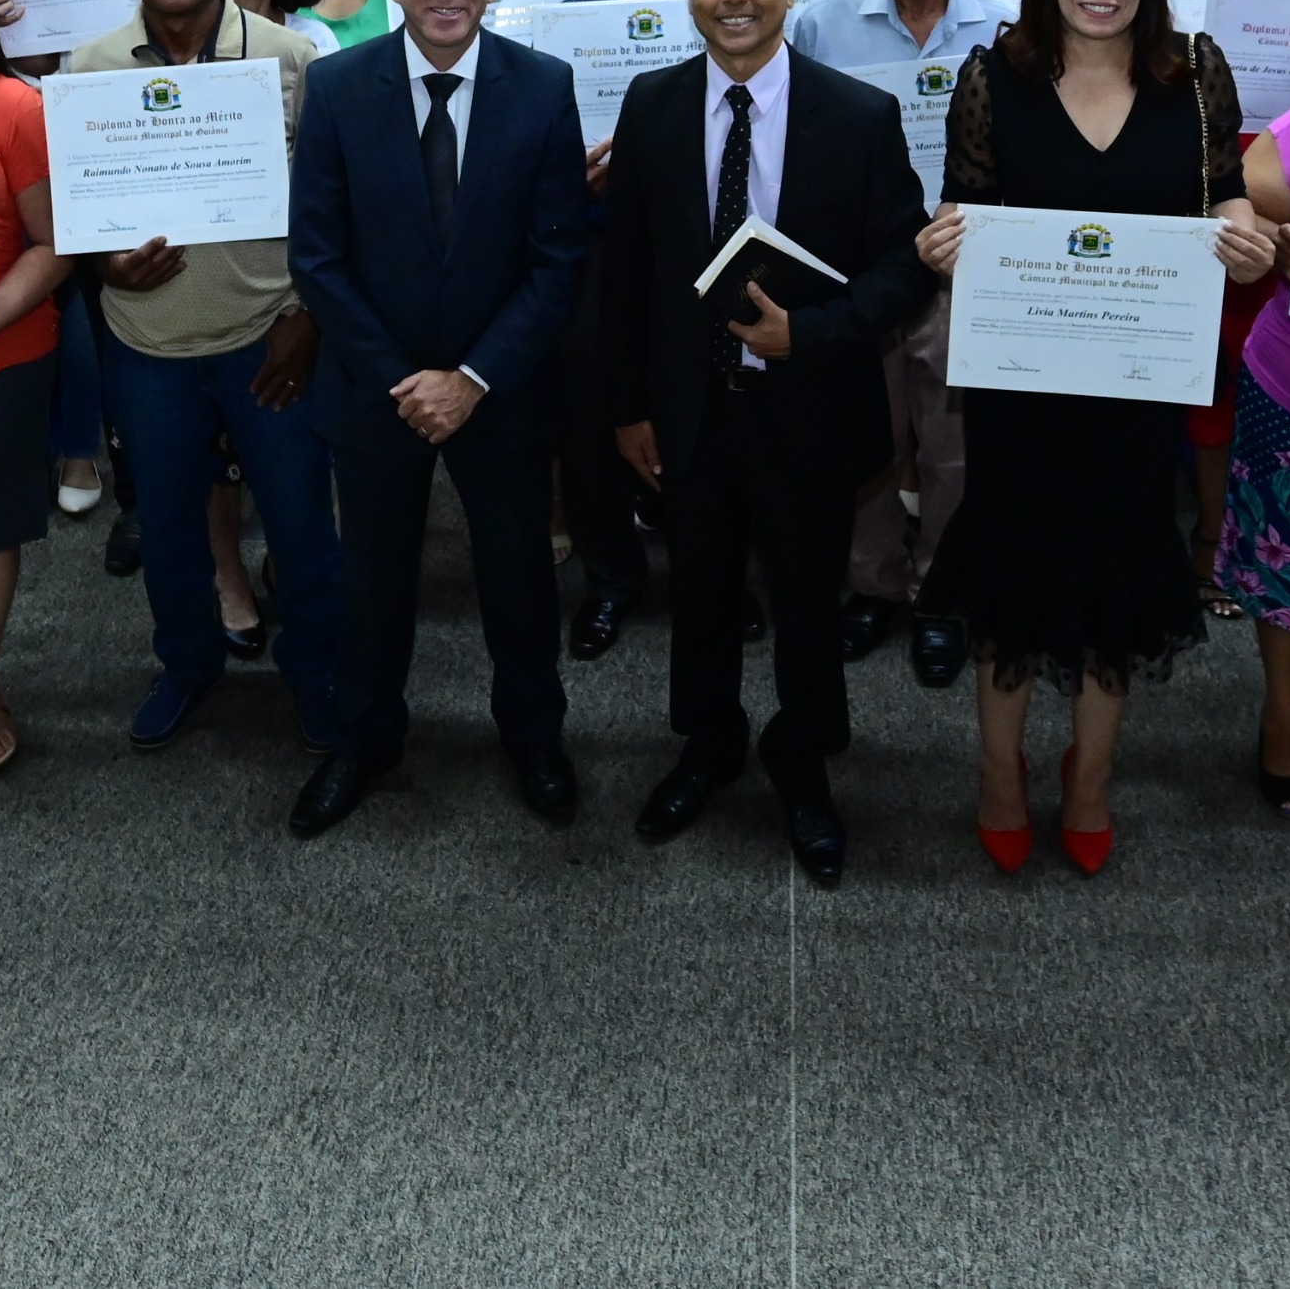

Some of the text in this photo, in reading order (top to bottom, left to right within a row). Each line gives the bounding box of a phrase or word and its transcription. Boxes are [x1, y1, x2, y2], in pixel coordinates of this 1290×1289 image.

[573, 48, 616, 57] Diploma
[620, 46, 630, 55] de
[635, 44, 667, 54] Honra
[1262, 65, 1286, 75] Jesus
[85, 110, 243, 132] Diploma de Honra ao Mérito
[916, 141, 946, 150] Moreir
[83, 157, 252, 178] Raimundo Nonato de Sousa Amorim
[999, 256, 1178, 278] Diploma de Honra ao Mérito
[1057, 309, 1098, 319] Martins
[1101, 311, 1141, 322] Pereira
